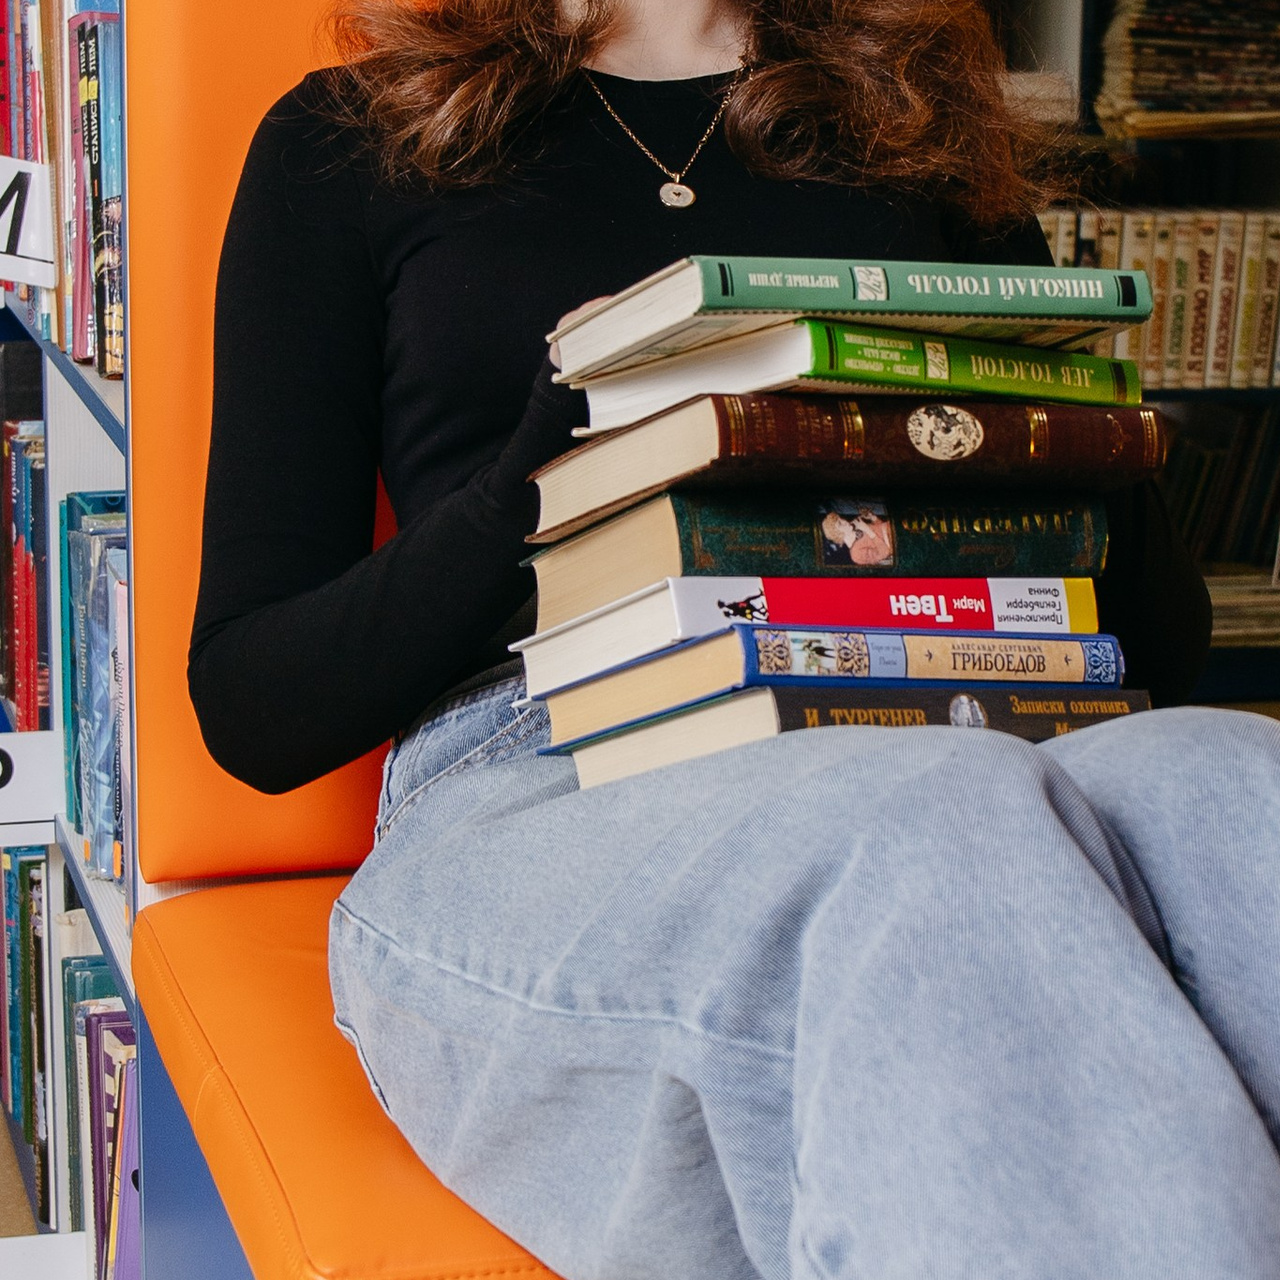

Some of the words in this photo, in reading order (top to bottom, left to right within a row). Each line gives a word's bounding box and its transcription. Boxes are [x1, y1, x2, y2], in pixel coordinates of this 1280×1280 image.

[79, 40, 87, 73] ЛЕМ
[89, 37, 97, 71] ЛЕМ
[747, 271, 782, 288] ДУШИ
[783, 273, 840, 289] МЕРТВЫЕ
[907, 272, 991, 298] ГОГОЛЬ
[996, 276, 1104, 302] НИКОЛАЙ
[970, 354, 1053, 385] ТОЛСТОЙ
[1060, 365, 1095, 389] ЛЕВ
[1027, 586, 1060, 598] Финна
[889, 594, 953, 623] Твен
[952, 598, 986, 613] Марк
[1005, 598, 1062, 612] Гекльберри
[997, 612, 1063, 625] Приключения
[952, 652, 1047, 675] ГРИБОЕДОВ
[1010, 695, 1066, 715] Записки
[1070, 699, 1131, 715] охотника
[804, 708, 819, 727] И
[830, 708, 928, 727] ТУРГЕНЕВ
